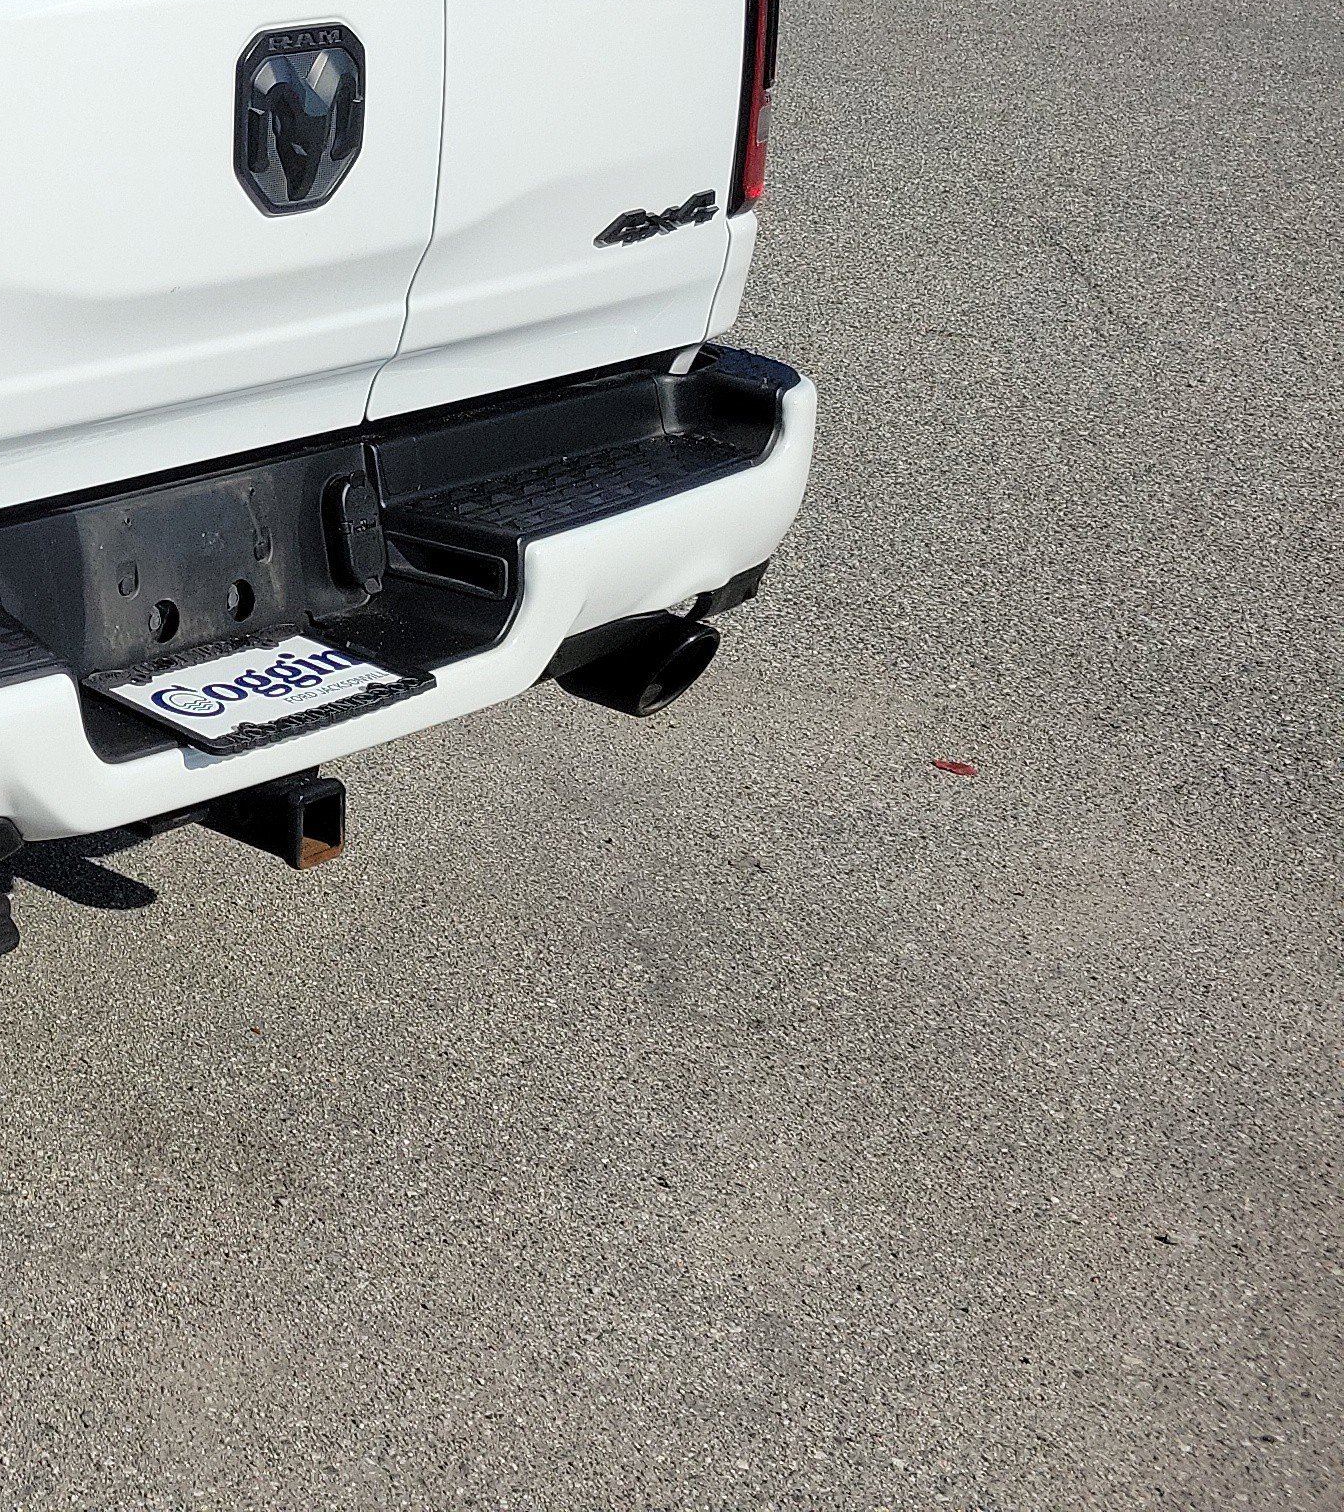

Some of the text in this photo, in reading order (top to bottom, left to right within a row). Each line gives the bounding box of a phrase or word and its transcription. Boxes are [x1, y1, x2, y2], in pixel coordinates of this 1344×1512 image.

[268, 29, 343, 51] RAM
[150, 649, 365, 718] Coggin
[283, 690, 314, 705] FORD
